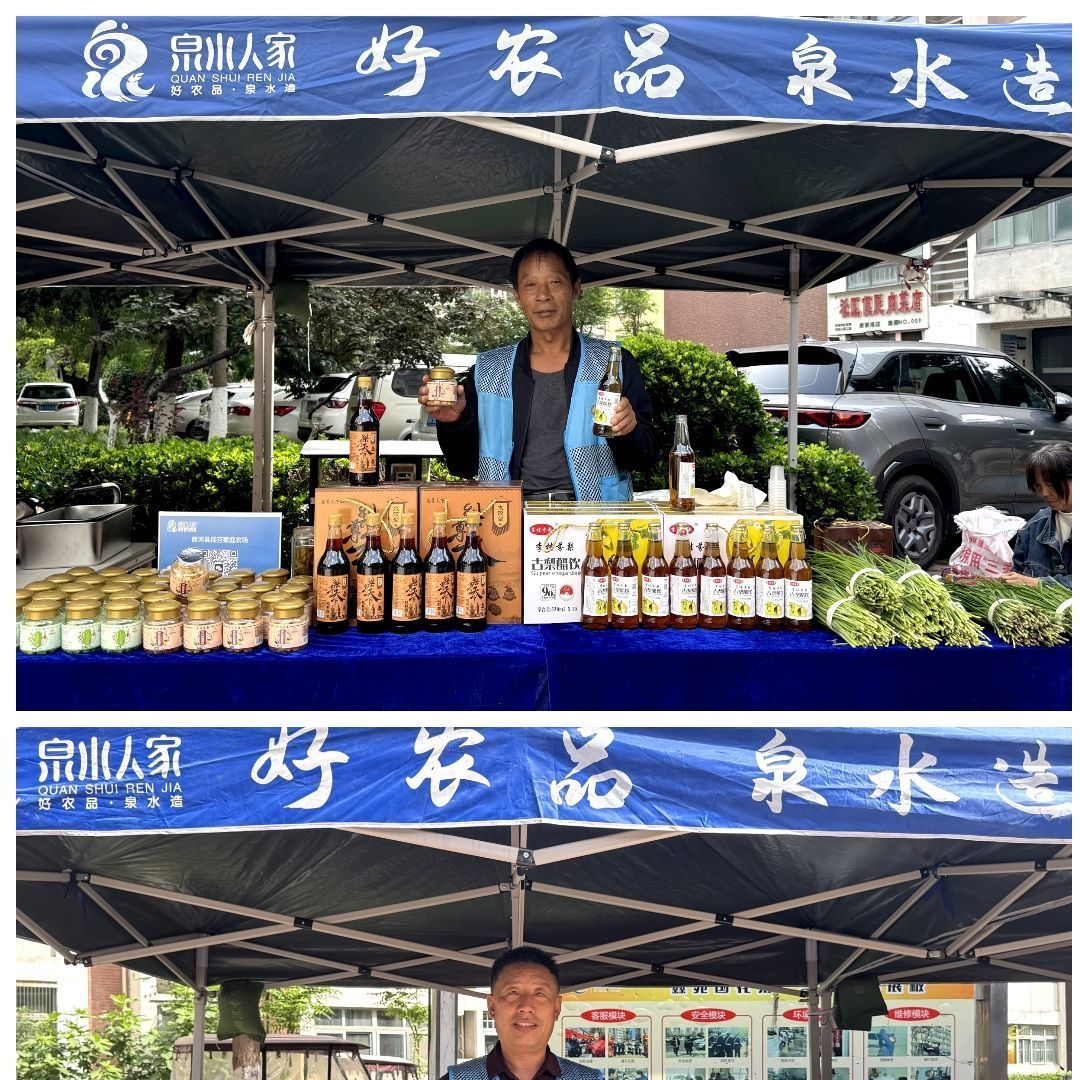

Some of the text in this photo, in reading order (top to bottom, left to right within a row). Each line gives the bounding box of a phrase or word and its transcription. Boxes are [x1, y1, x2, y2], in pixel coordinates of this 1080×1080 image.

[170, 32, 296, 72] 泉水人家
[356, 23, 1072, 116] 好农品 泉水造
[171, 73, 296, 83] QUAN SHUI REN JIA
[531, 557, 580, 570] 古梨醋饮
[38, 736, 182, 782] 泉水人家
[251, 727, 1072, 817] 好农品 泉水造
[38, 782, 182, 795] QUAN SHUI REN JIA
[590, 1010, 627, 1021] 客服模块
[690, 1010, 726, 1021] 安全模块
[894, 1009, 929, 1020] 维修模块
